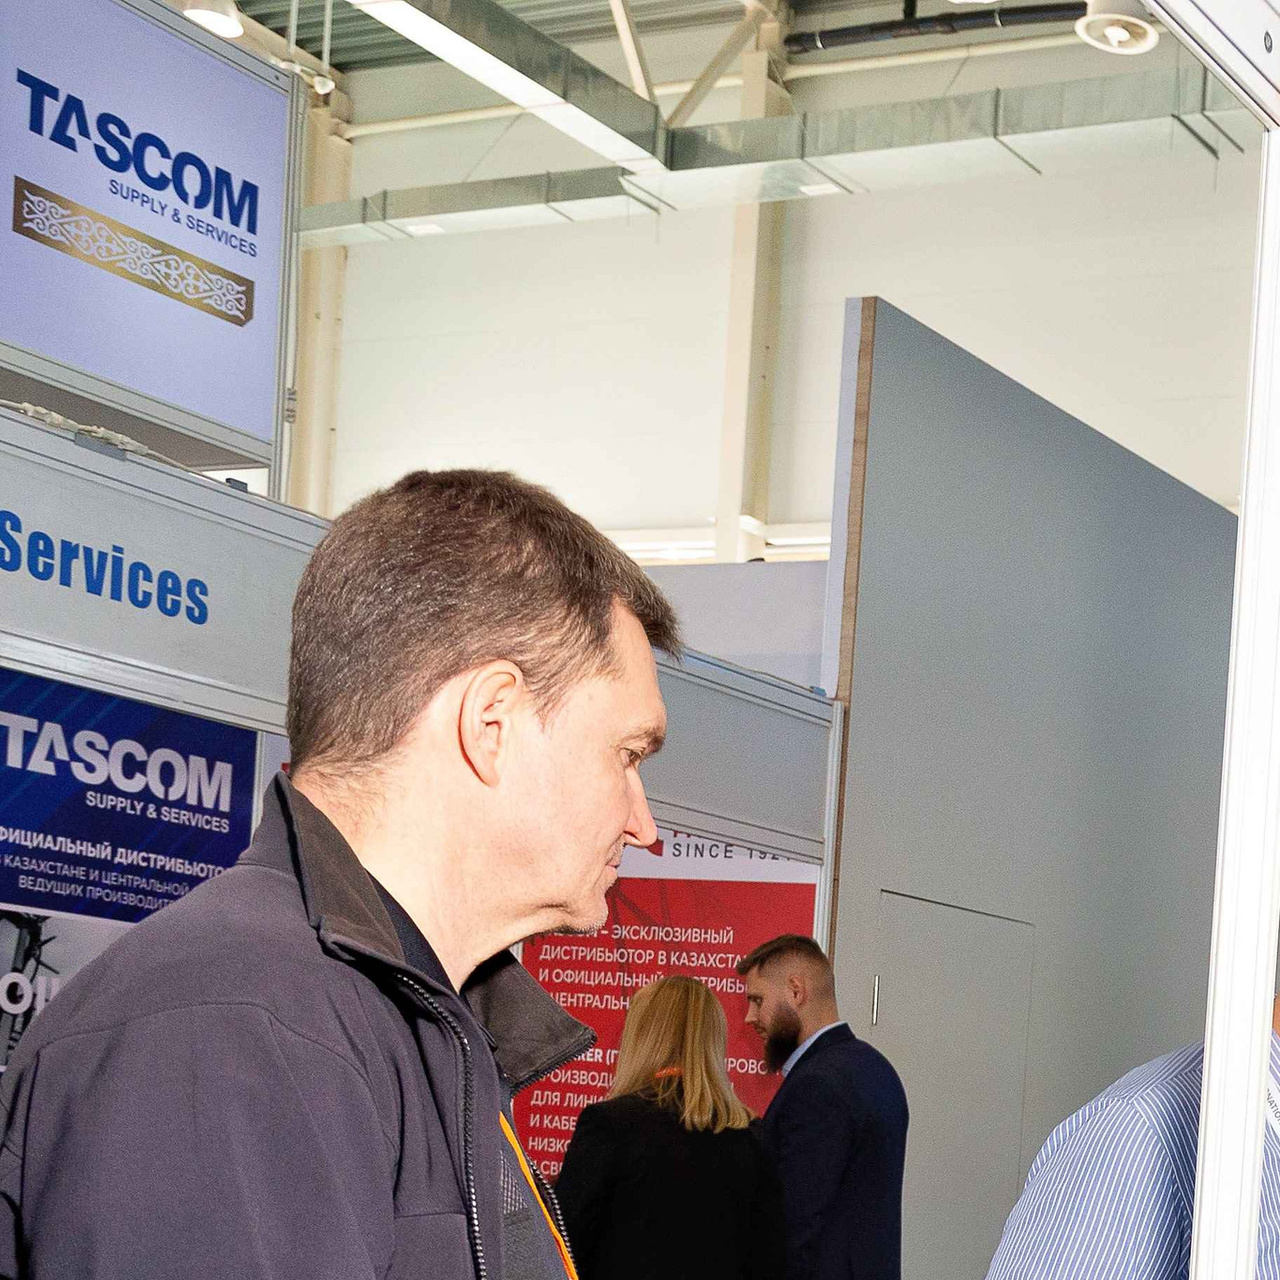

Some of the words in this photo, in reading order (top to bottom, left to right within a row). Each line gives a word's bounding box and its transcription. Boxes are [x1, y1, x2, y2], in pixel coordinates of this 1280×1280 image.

[16, 67, 259, 235] TASCOM
[109, 179, 167, 217] SUPPLY
[172, 208, 182, 224] &
[186, 213, 258, 258] SERVICES
[0, 509, 209, 625] Services
[0, 710, 233, 813] TASCOM
[86, 790, 144, 816] SUPPLY
[146, 803, 157, 818] &
[160, 806, 230, 834] SERVICES
[672, 842, 734, 860] SINCE
[4, 854, 87, 880] КАЗАХСТАНЕ
[90, 869, 99, 881] И
[18, 875, 84, 899] ВЕДУЩИХ
[611, 924, 734, 945] ЭКСКЛЮЗИВНЫЙ
[539, 944, 655, 964] ДИСТРИБЬЮТОР
[657, 951, 667, 965] В
[538, 968, 549, 981] И
[530, 1090, 560, 1107] ДЛЯ
[530, 1113, 540, 1128] И
